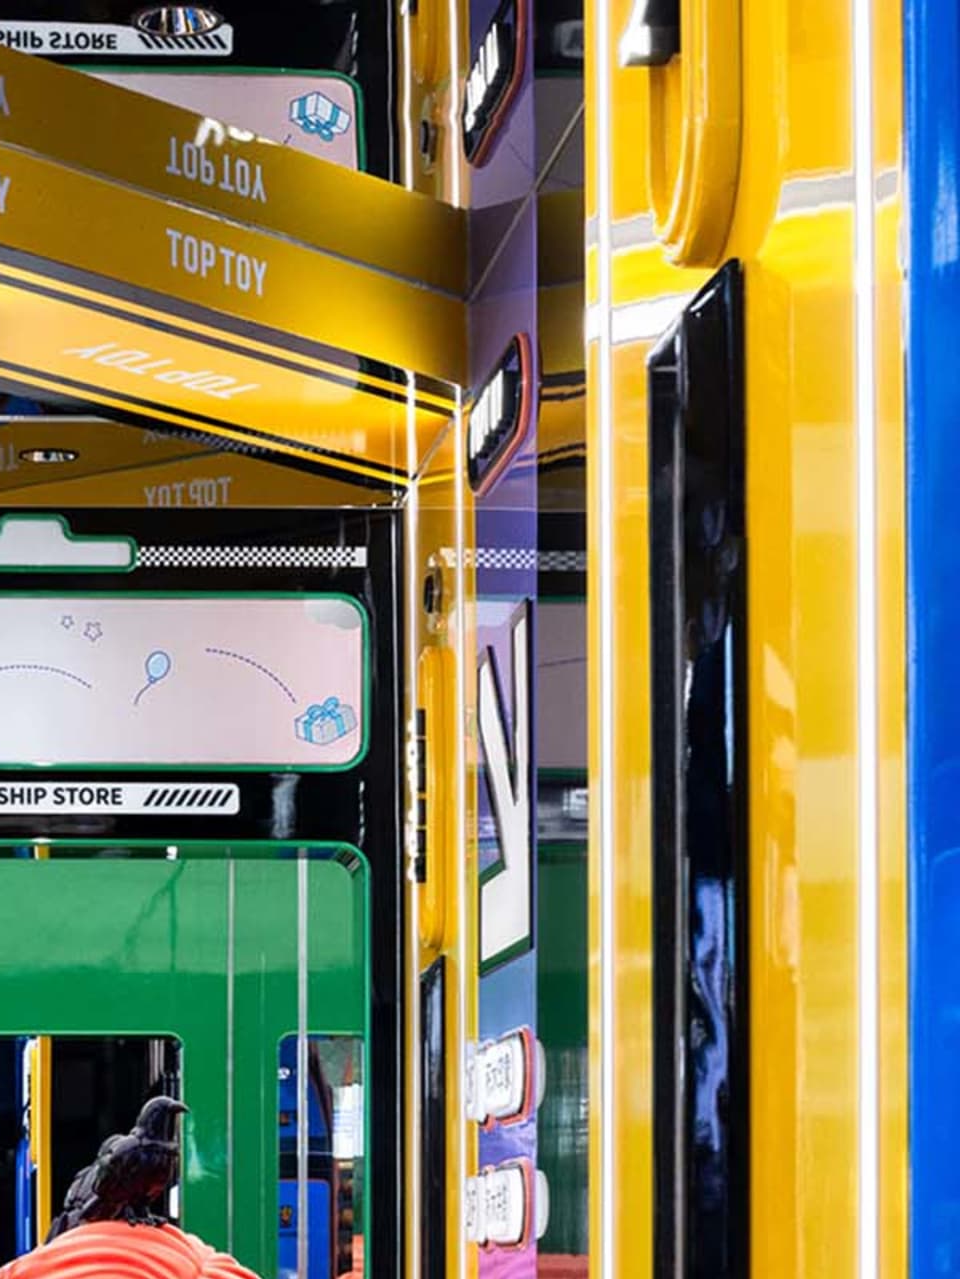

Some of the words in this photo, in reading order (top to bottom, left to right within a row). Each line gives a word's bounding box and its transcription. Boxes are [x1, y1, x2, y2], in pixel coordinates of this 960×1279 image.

[165, 228, 215, 278] TOP
[219, 246, 267, 297] TOY
[53, 786, 123, 806] STORE
